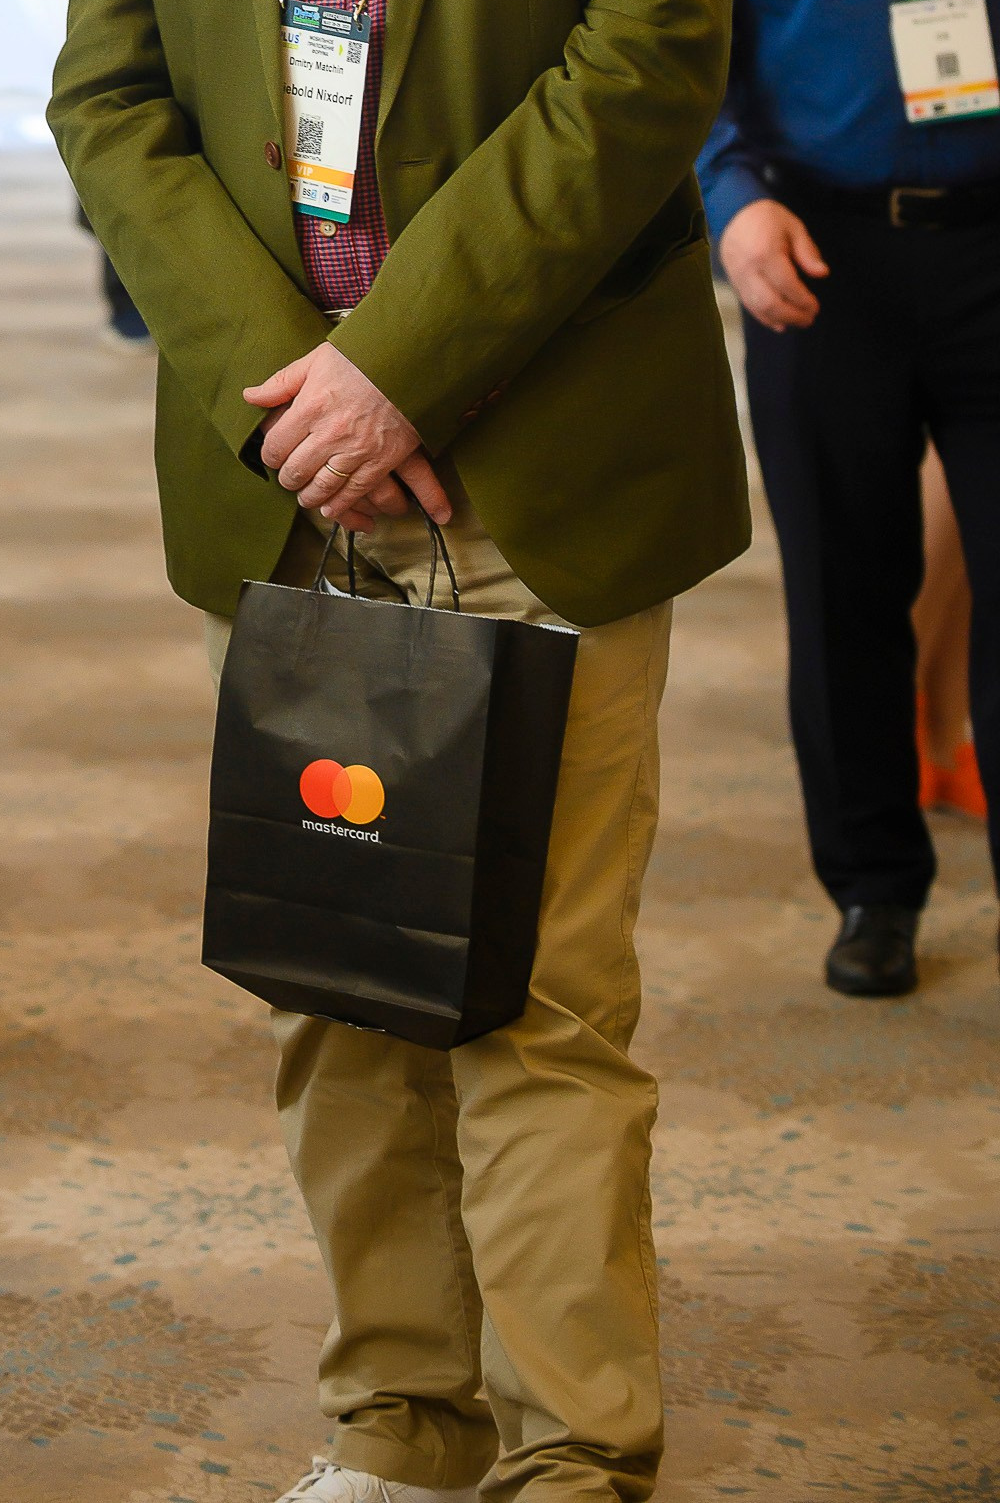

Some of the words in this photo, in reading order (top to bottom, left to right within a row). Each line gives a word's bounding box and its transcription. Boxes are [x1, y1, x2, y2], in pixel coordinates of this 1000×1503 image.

[282, 32, 300, 44] LUS
[289, 56, 313, 71] Dmitry
[315, 61, 344, 74] Matchin
[283, 82, 314, 99] iebold
[316, 88, 353, 106] Nixdorf
[296, 164, 314, 176] VIP
[302, 819, 380, 843] mastercard
